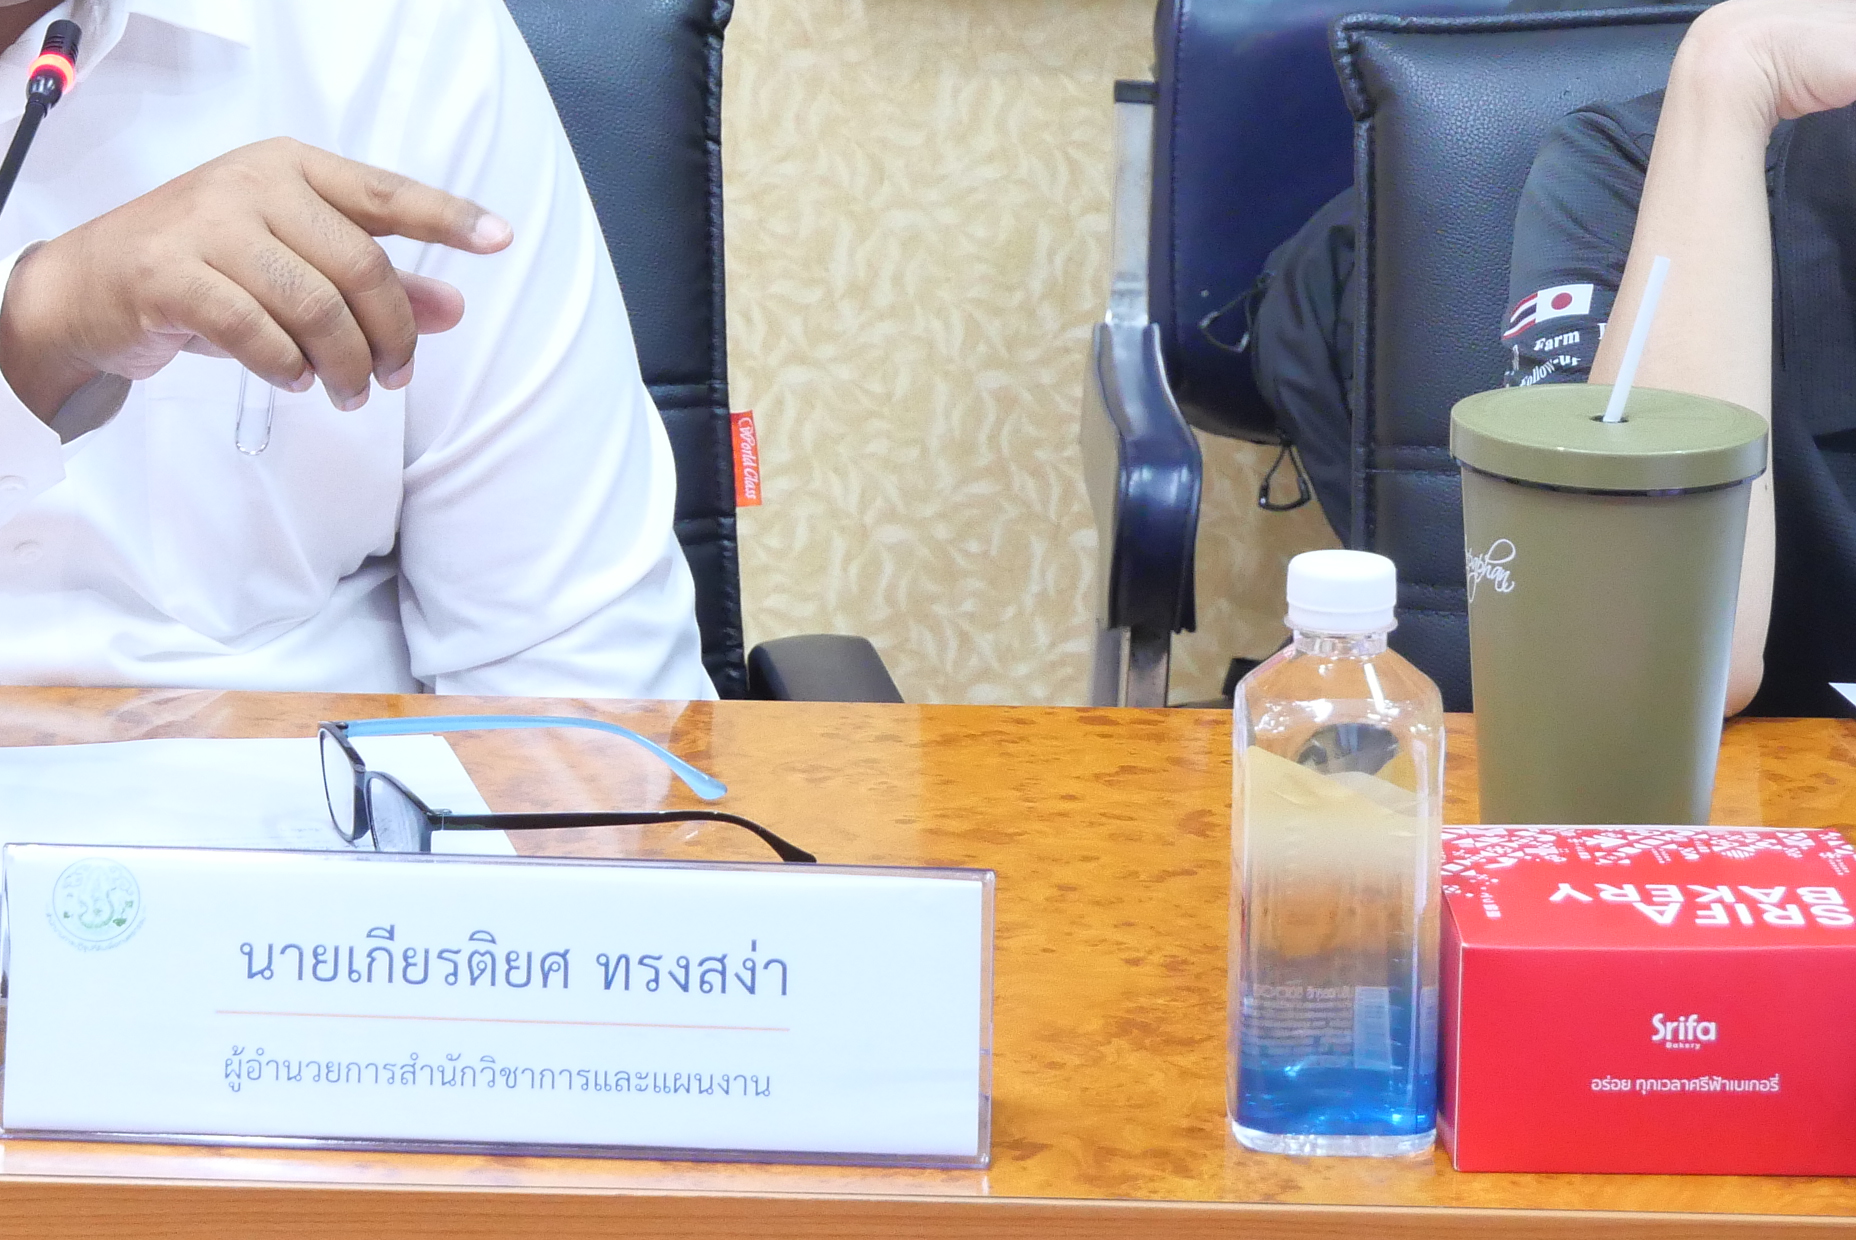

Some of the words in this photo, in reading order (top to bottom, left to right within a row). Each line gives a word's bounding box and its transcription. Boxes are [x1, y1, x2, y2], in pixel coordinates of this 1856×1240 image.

[1533, 330, 1581, 352] Farm
[1548, 882, 1845, 905] BAKERY
[1633, 902, 1856, 927] SRIFA
[239, 923, 571, 990] นายเกียรติยศ
[595, 938, 788, 996] ทรงสง่า
[1651, 1012, 1718, 1042] Srifa
[1665, 1041, 1701, 1050] Bakery
[224, 1044, 772, 1097] ผู้อำนวยการสำนักวิชาการและแผนงาน
[1590, 1074, 1632, 1092] อร่อย
[1635, 1073, 1781, 1095] ทุกเวลาศรีฟ้าเบเกอรี่
